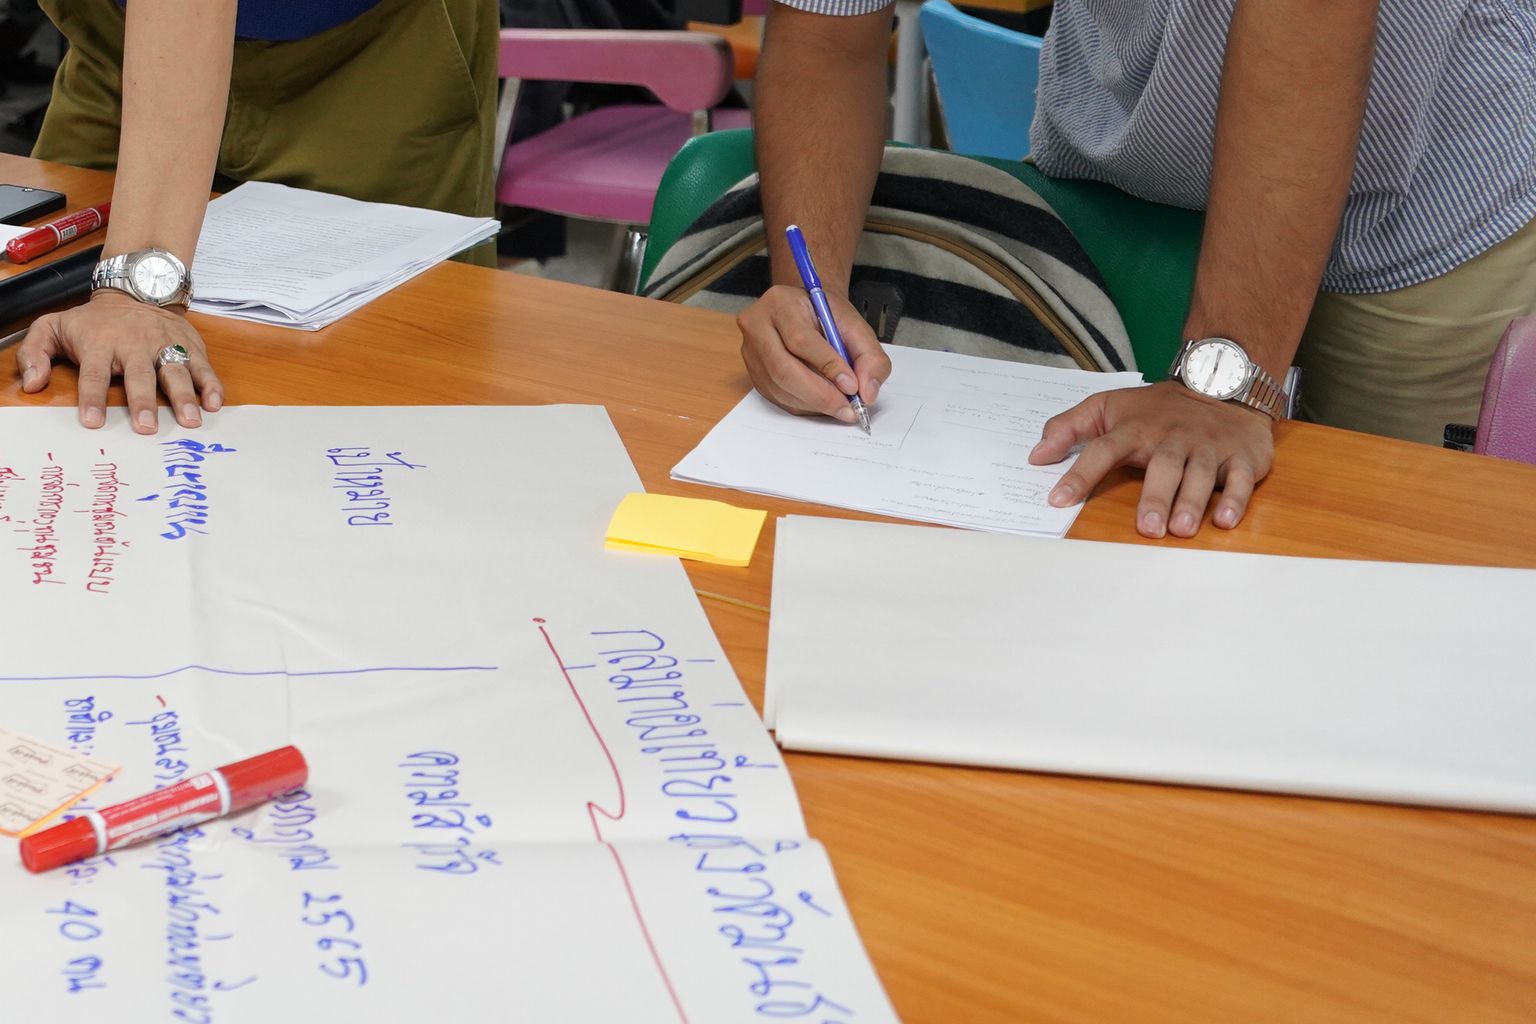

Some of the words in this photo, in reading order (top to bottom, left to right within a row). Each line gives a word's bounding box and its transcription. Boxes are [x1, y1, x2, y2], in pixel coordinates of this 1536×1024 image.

[326, 446, 426, 527] เป้าหมาย
[44, 899, 102, 942] 40
[302, 890, 368, 987] 2565
